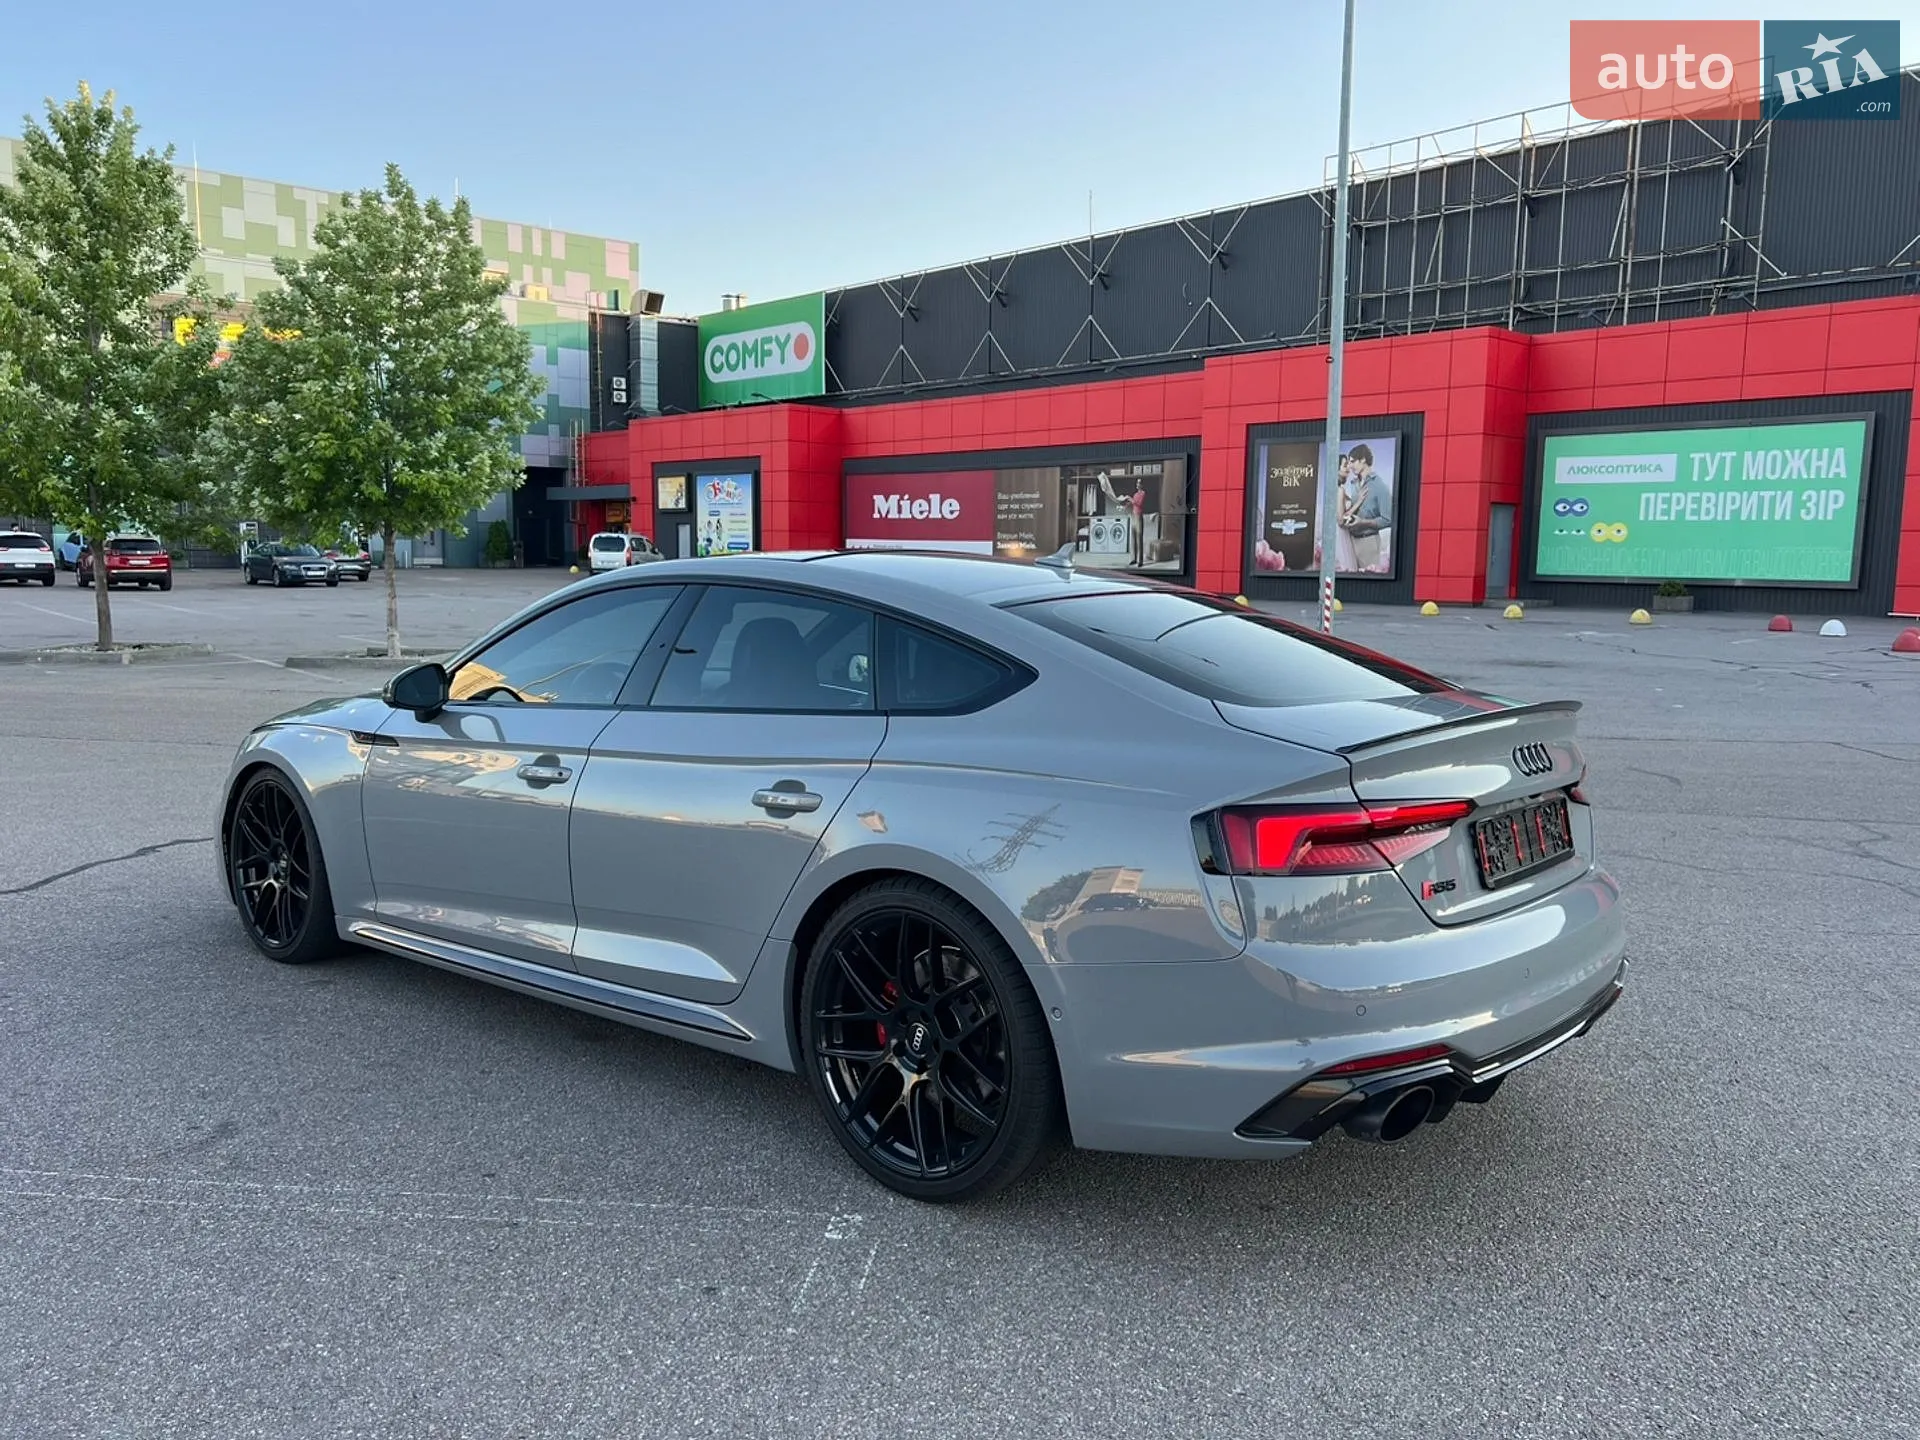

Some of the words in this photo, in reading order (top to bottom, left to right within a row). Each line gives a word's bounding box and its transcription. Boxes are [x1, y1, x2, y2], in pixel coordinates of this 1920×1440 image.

[709, 333, 791, 375] COMFY
[1567, 463, 1664, 476] ЛЮКСОПТИКА
[1689, 450, 1736, 482] ТУТ
[1742, 447, 1847, 481] МОЖНА
[872, 493, 961, 520] Miele
[1639, 490, 1794, 521] ПЕРЕВІРИТИ
[1800, 489, 1846, 521] ЗІР
